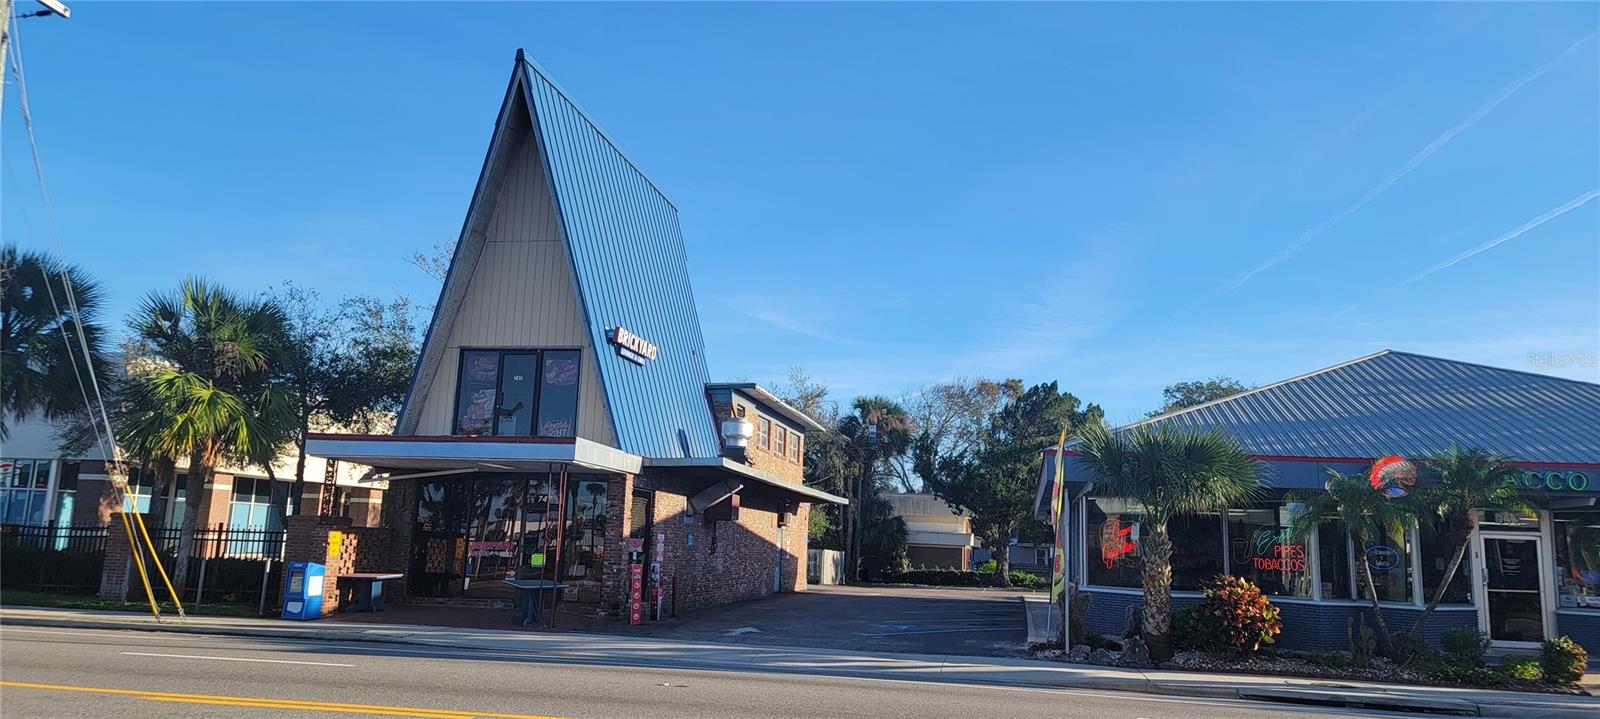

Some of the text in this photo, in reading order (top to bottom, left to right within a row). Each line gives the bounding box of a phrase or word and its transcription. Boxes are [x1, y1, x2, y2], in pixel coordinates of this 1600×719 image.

[617, 326, 657, 360] BRICKYARD
[1273, 543, 1305, 559] PIPES
[1252, 557, 1306, 571] TOBACCOS
